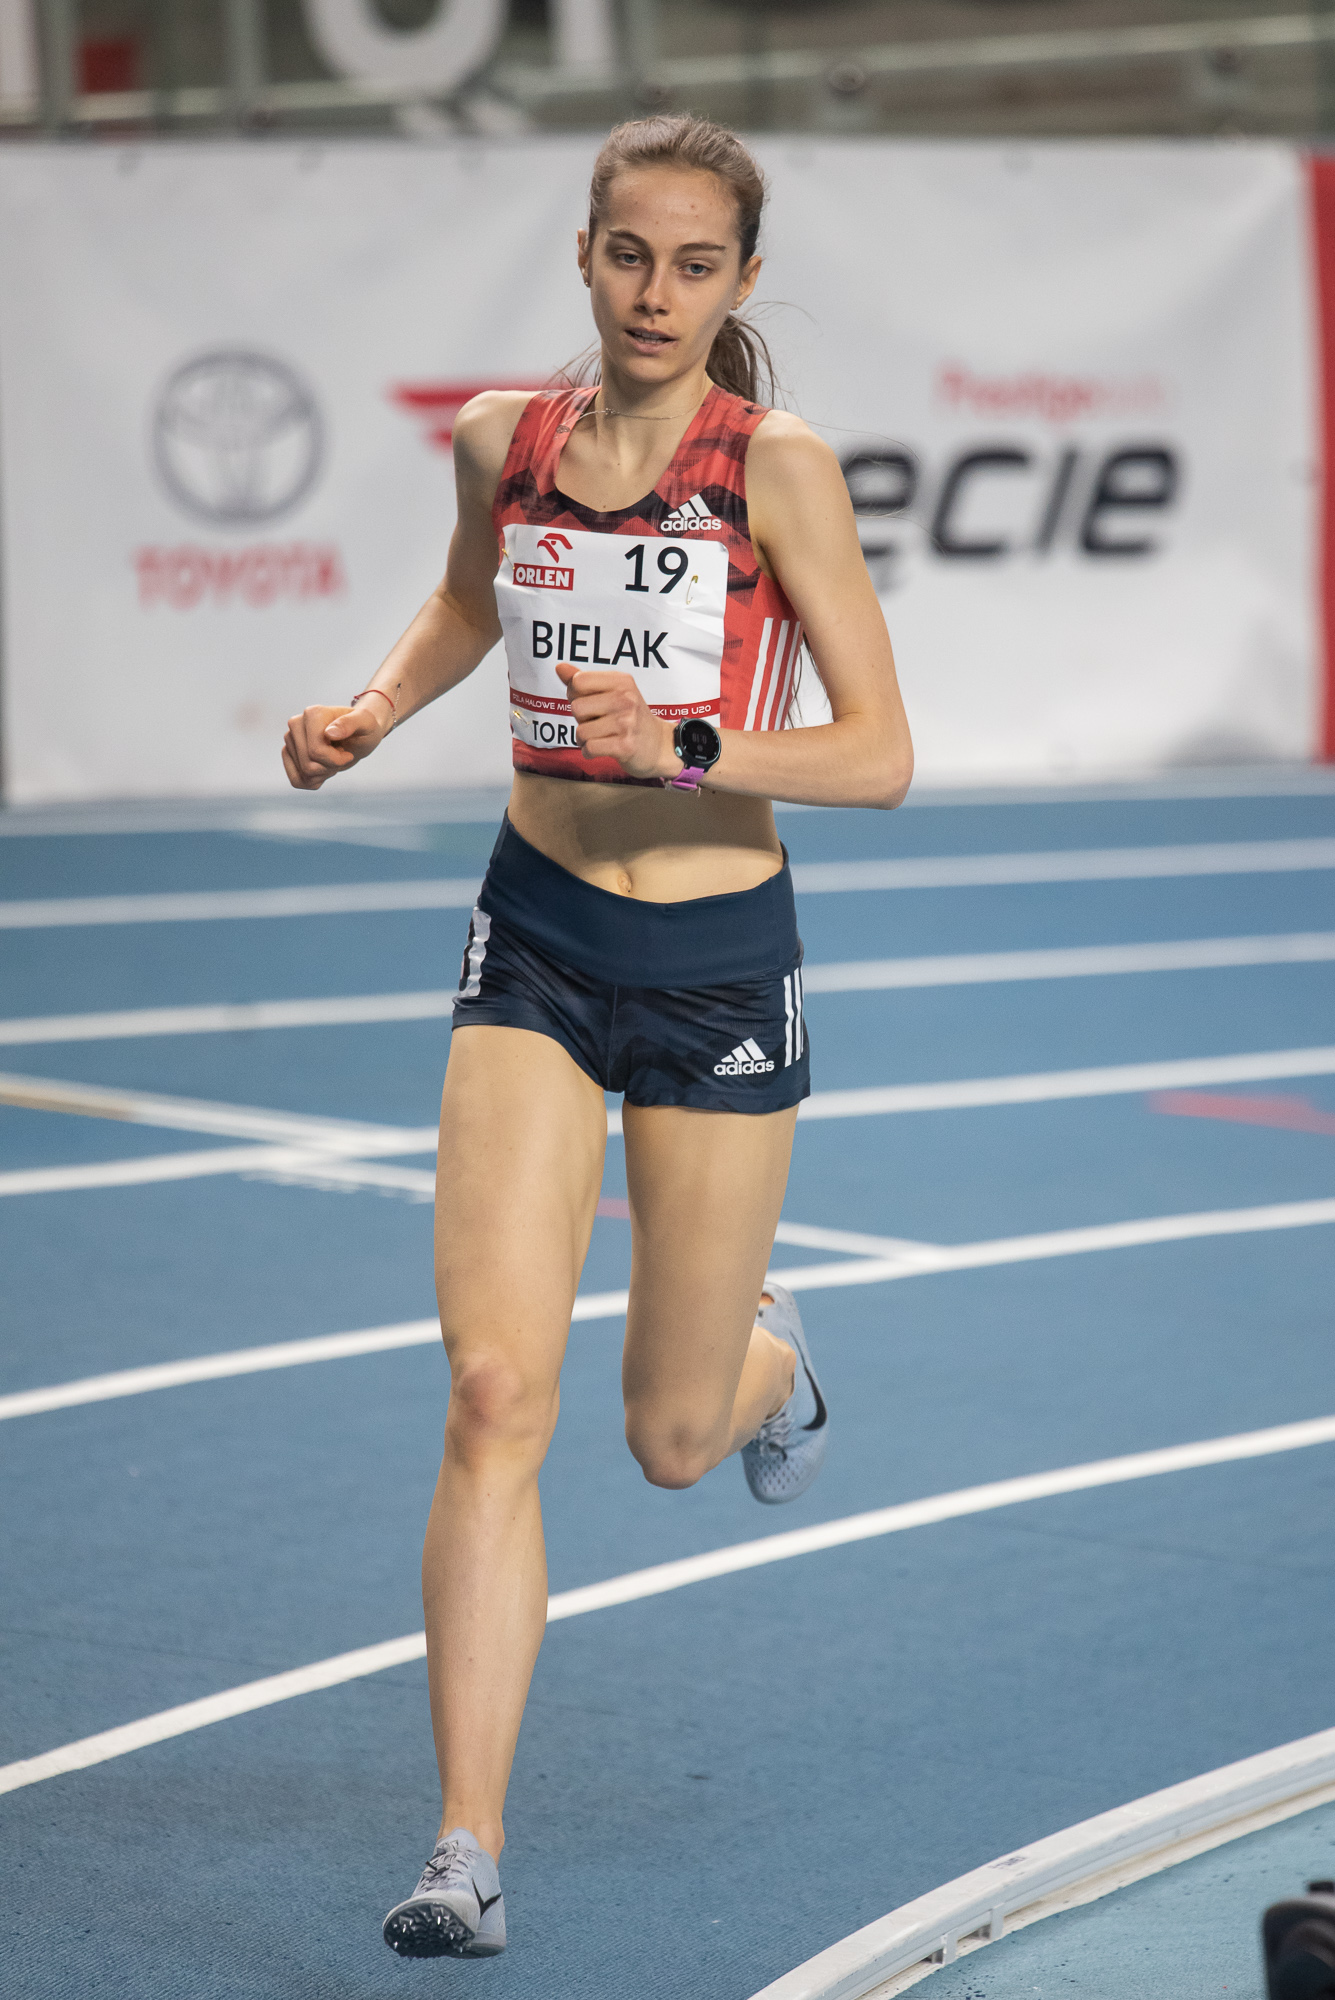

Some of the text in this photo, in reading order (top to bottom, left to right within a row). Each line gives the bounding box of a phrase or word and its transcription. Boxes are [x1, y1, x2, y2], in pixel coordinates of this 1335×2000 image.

[660, 516, 722, 532] adidas
[133, 543, 346, 609] TOYOTA
[515, 567, 570, 588] ORLEN
[624, 544, 689, 594] 19
[532, 620, 669, 669] BIELAK
[525, 698, 555, 710] HALOWE
[669, 708, 689, 716] U18
[691, 704, 712, 715] U20
[713, 1058, 775, 1076] adidas
